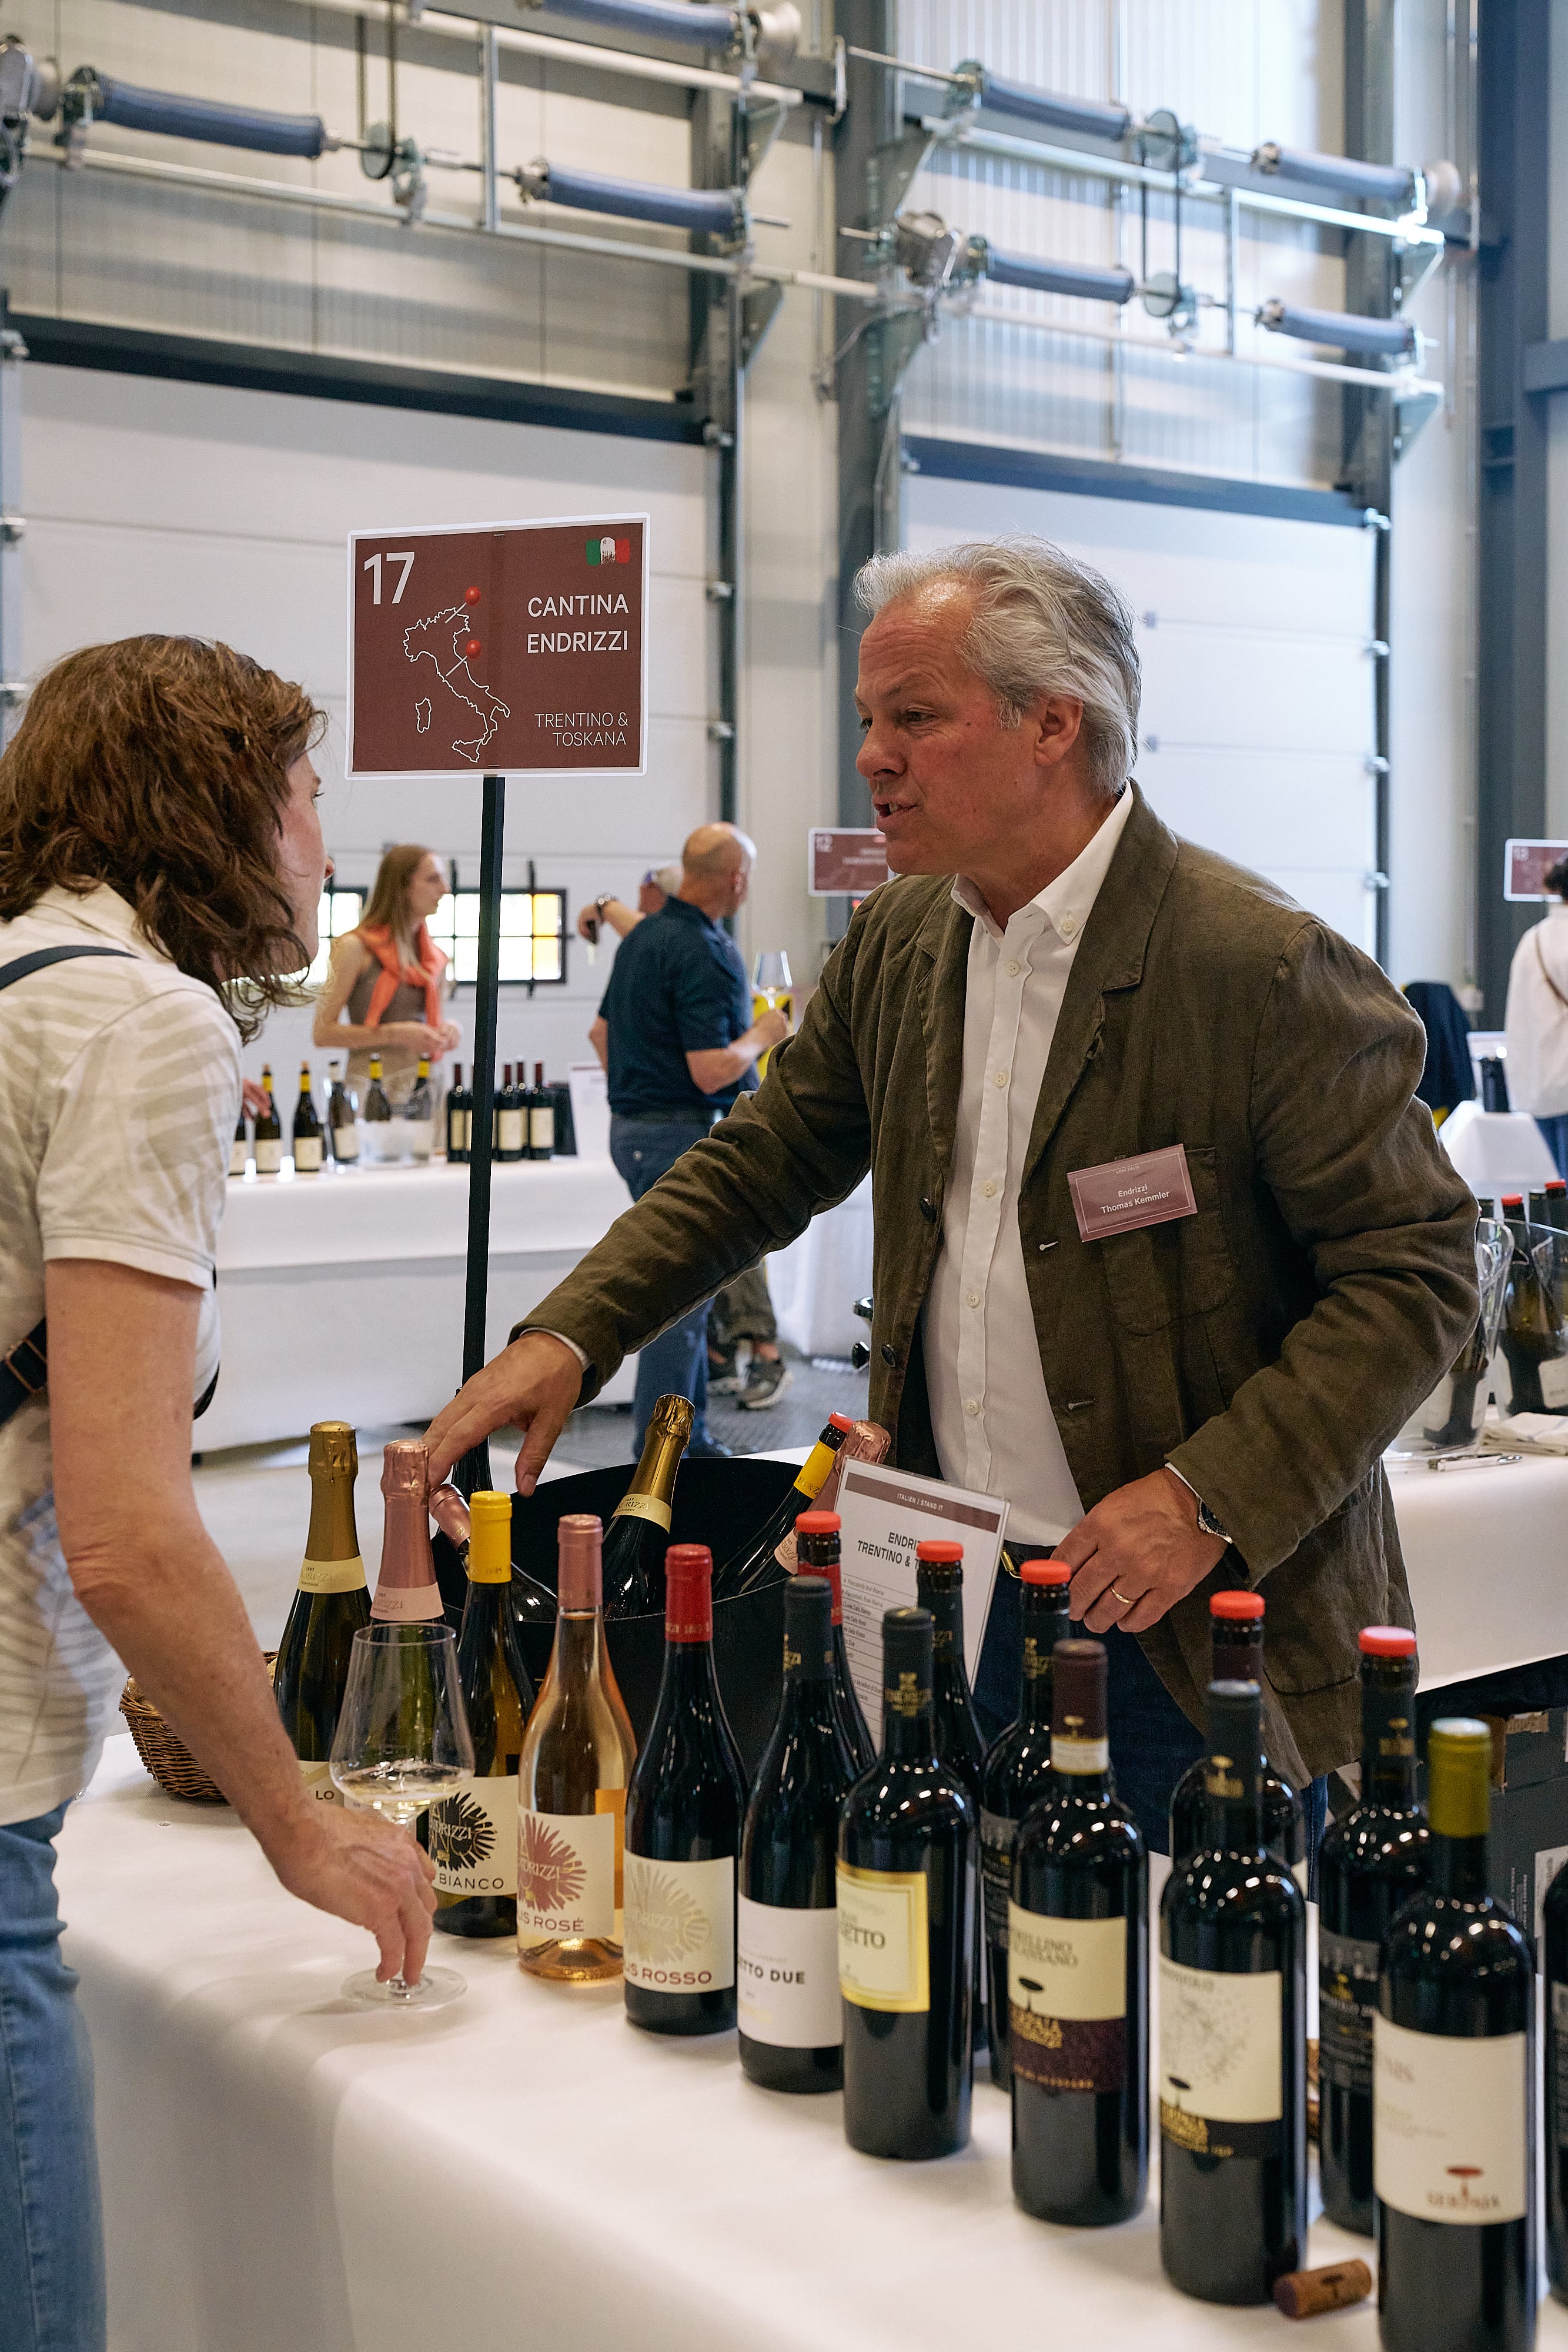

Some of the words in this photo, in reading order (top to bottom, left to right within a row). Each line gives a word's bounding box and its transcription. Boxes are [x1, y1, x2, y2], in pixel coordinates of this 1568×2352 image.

[364, 552, 415, 604] 17
[527, 593, 629, 617] CANTINA
[527, 630, 628, 654] ENDRIZZI
[535, 712, 613, 727] TRENTINO
[618, 711, 628, 727] &
[553, 731, 627, 746] TOSKANA
[1118, 1184, 1148, 1197] Endrizzi
[1101, 1201, 1134, 1214] Thomas
[1134, 1191, 1170, 1205] Kemmler
[897, 1493, 916, 1504] ITALIEN
[921, 1499, 937, 1510] STAND
[888, 1532, 921, 1551] ENDRI
[858, 1540, 902, 1564] TRENTINO
[905, 1555, 911, 1568] &
[439, 1873, 504, 1890] BIANCO
[534, 1916, 584, 1932] ROSÉ
[642, 1967, 713, 1985] ROSSO
[770, 1969, 805, 1985] DUE
